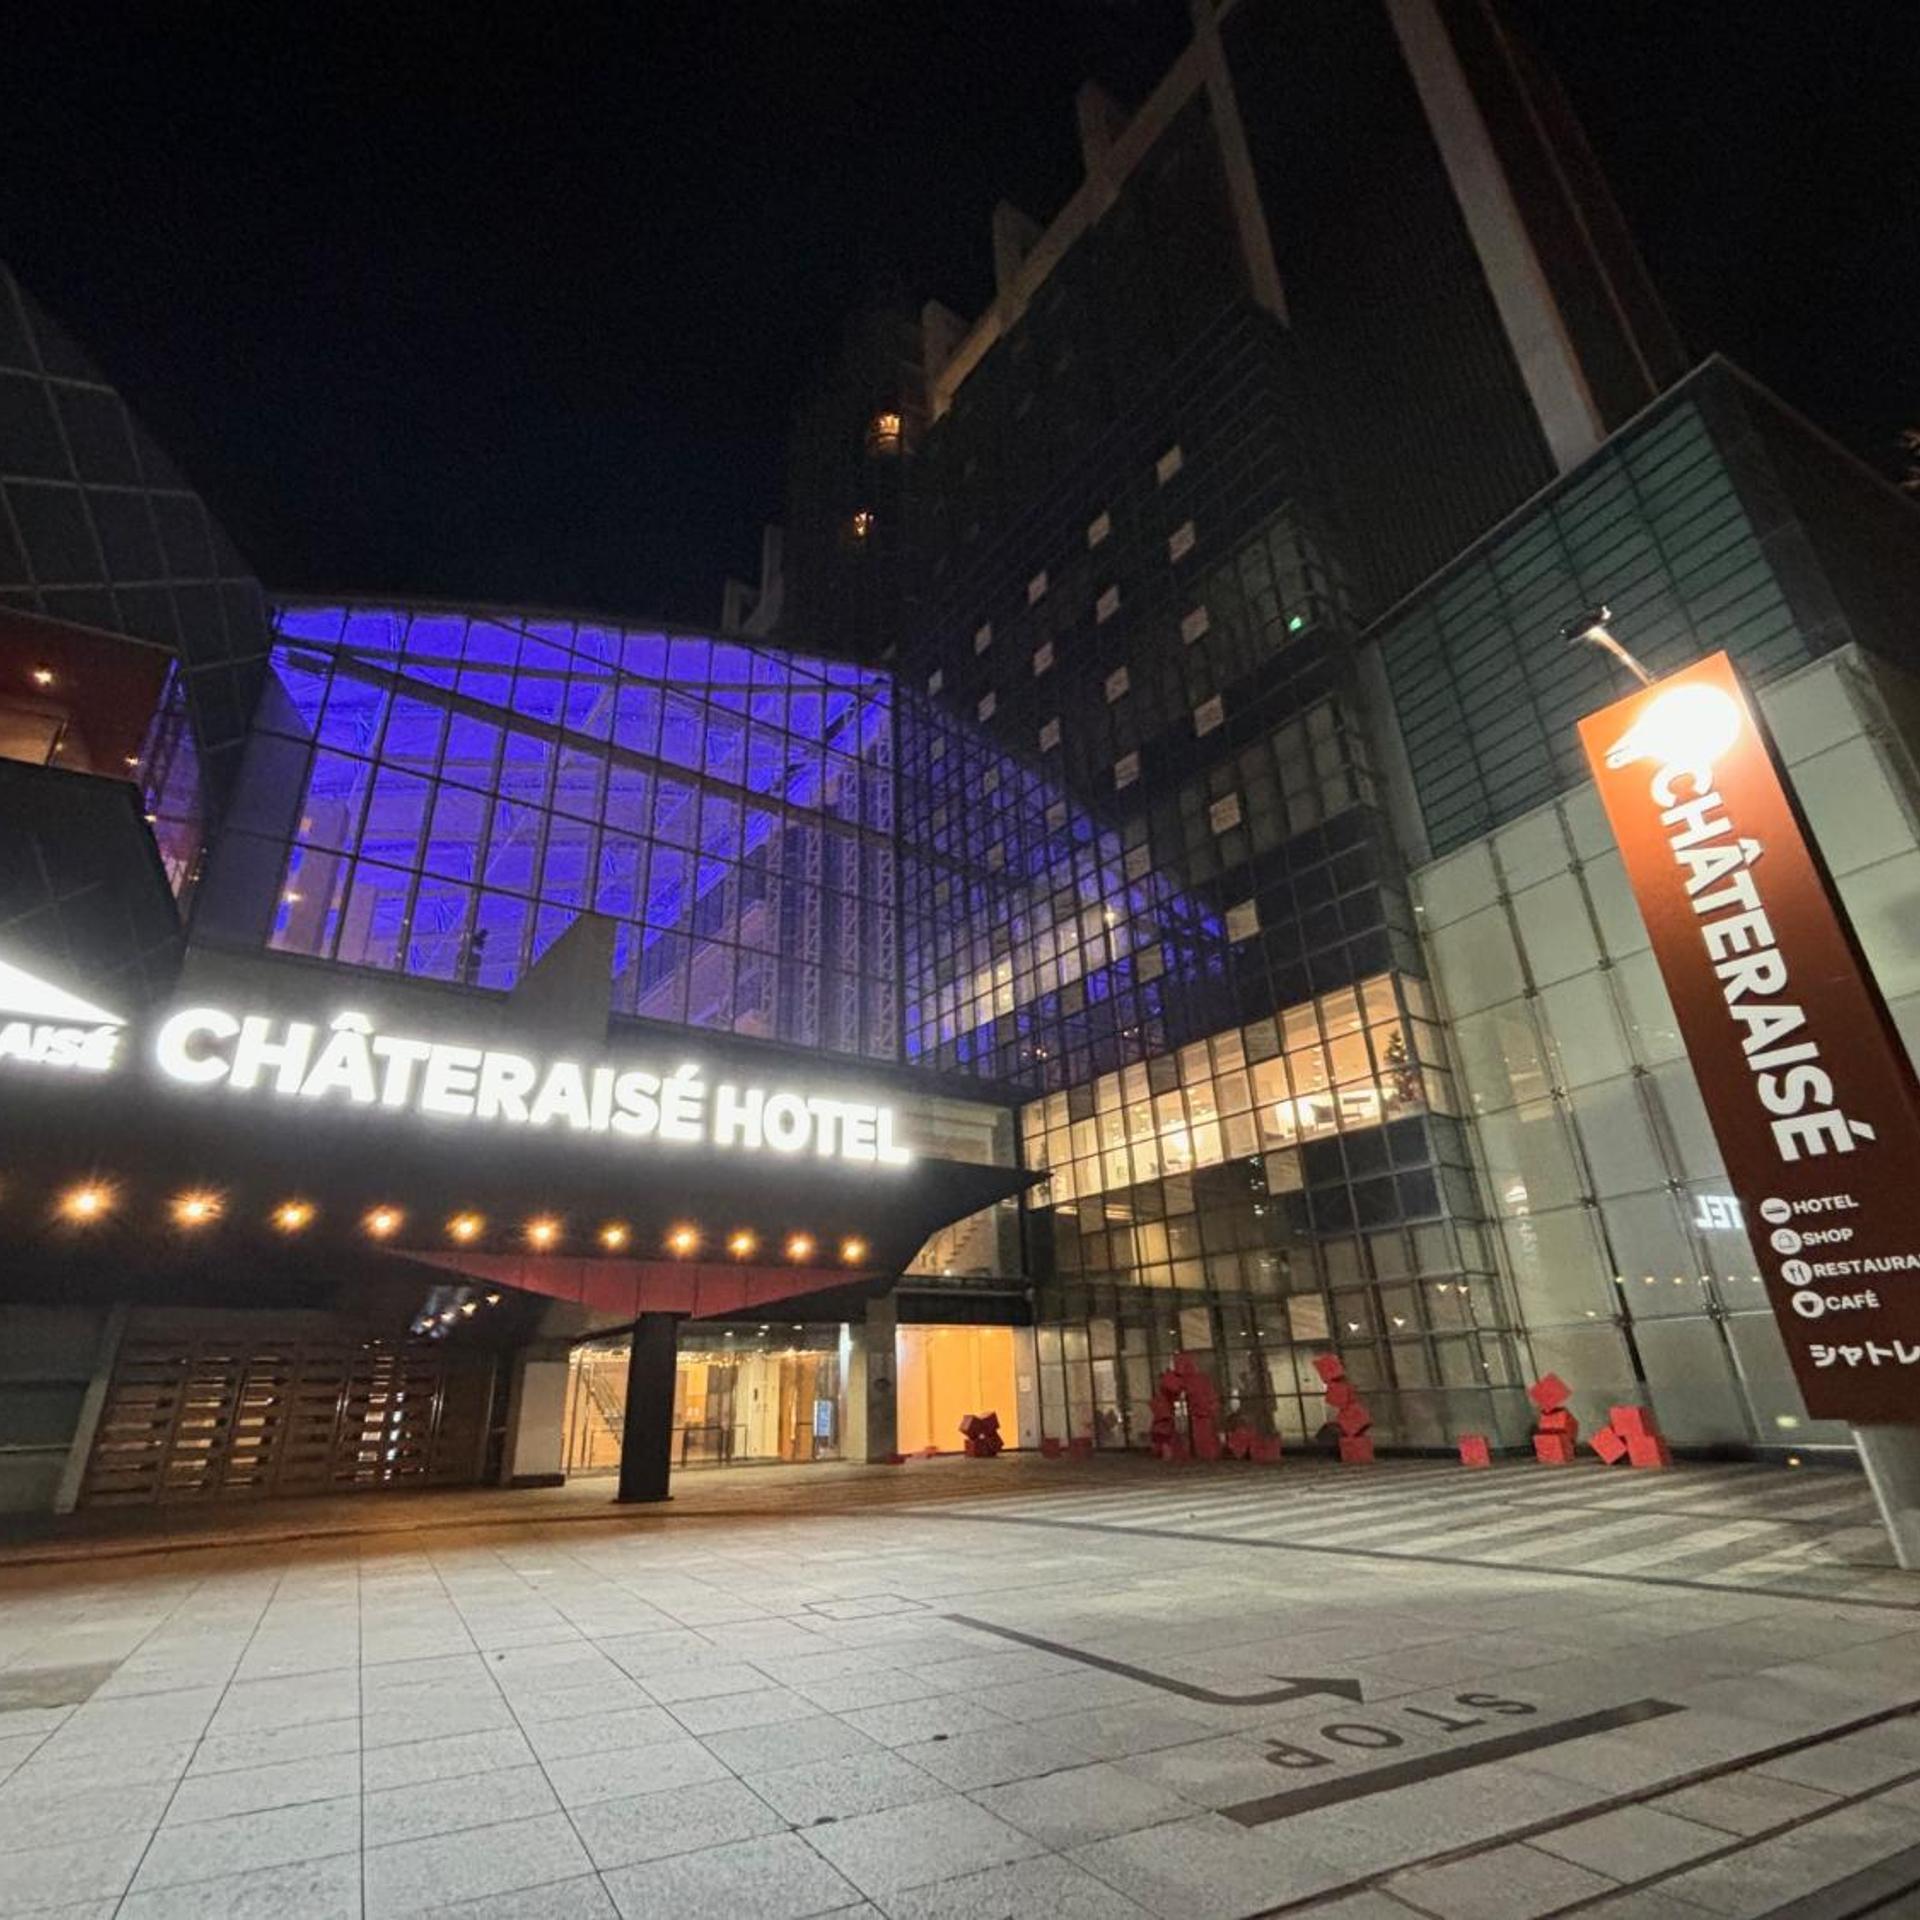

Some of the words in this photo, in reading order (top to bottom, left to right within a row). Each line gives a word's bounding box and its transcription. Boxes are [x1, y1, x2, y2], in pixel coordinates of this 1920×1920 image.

[1651, 757, 1876, 1162] CHÂTERAISÉ
[156, 1007, 706, 1142] CHÂTERAISÉ
[714, 1085, 911, 1164] HOTEL
[1792, 1194, 1859, 1215] HOTEL
[1802, 1228, 1853, 1246] SHOP
[1812, 1253, 1920, 1277] RESTAURA
[1825, 1289, 1880, 1311] CAFÉ
[1809, 1340, 1920, 1367] シャトレ
[1264, 1692, 1538, 1769] STOP
